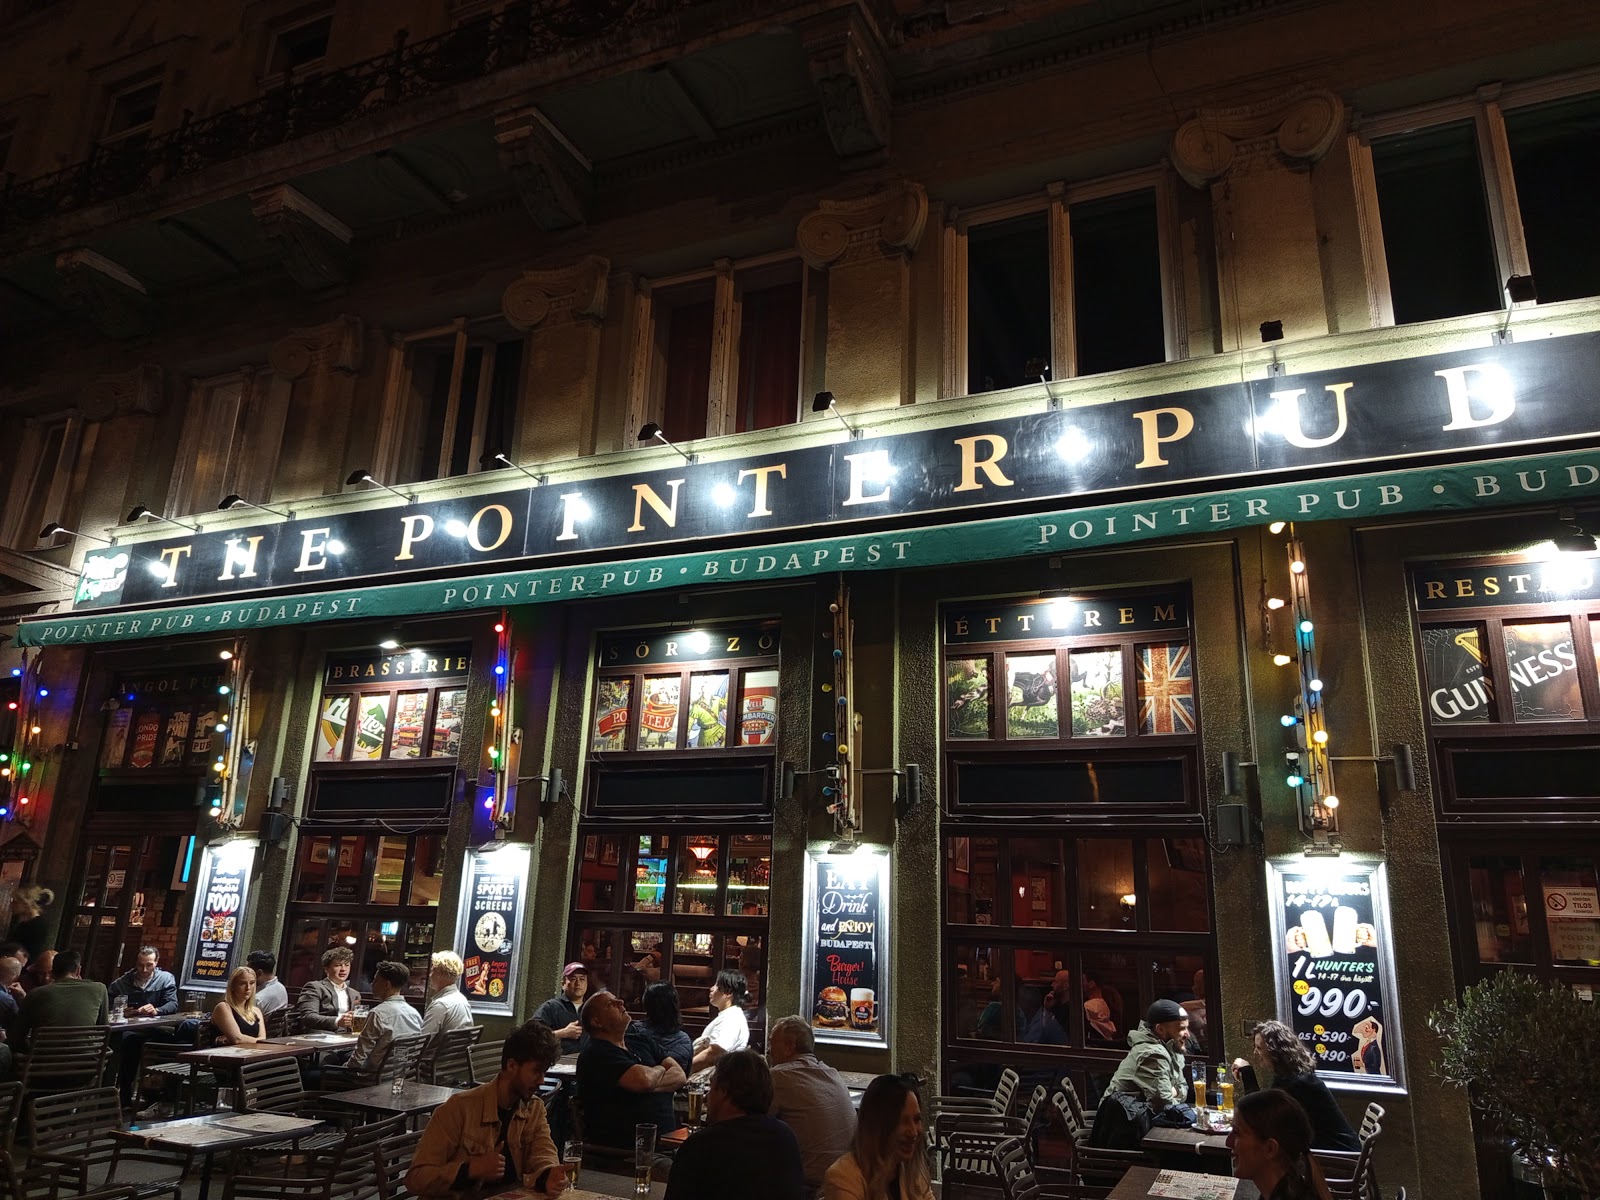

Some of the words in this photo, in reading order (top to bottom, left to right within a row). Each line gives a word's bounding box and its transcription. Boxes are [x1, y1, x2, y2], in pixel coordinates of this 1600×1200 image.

[160, 527, 331, 588] THE
[394, 432, 1014, 563] POINTER
[1132, 361, 1520, 471] PUB
[1039, 498, 1270, 545] POINTER
[1296, 485, 1405, 514] PUB
[442, 575, 586, 604] POINTER
[600, 567, 664, 589] PUB
[702, 541, 912, 577] BUDAPEST
[40, 619, 141, 641] POINTER
[149, 614, 194, 632] PUB
[218, 597, 362, 625] BUDAPEST
[955, 604, 1177, 636] ÉTTREM
[333, 656, 467, 679] BRASSERIE
[136, 733, 158, 742] PRIDE
[476, 883, 514, 895] SPORTS
[205, 892, 241, 912] FOOD
[475, 900, 513, 911] SCREENS
[822, 890, 872, 914] Drink
[820, 918, 838, 932] and
[1292, 955, 1307, 978] 1
[1315, 960, 1375, 973] HUNTER'S
[831, 971, 859, 986] House
